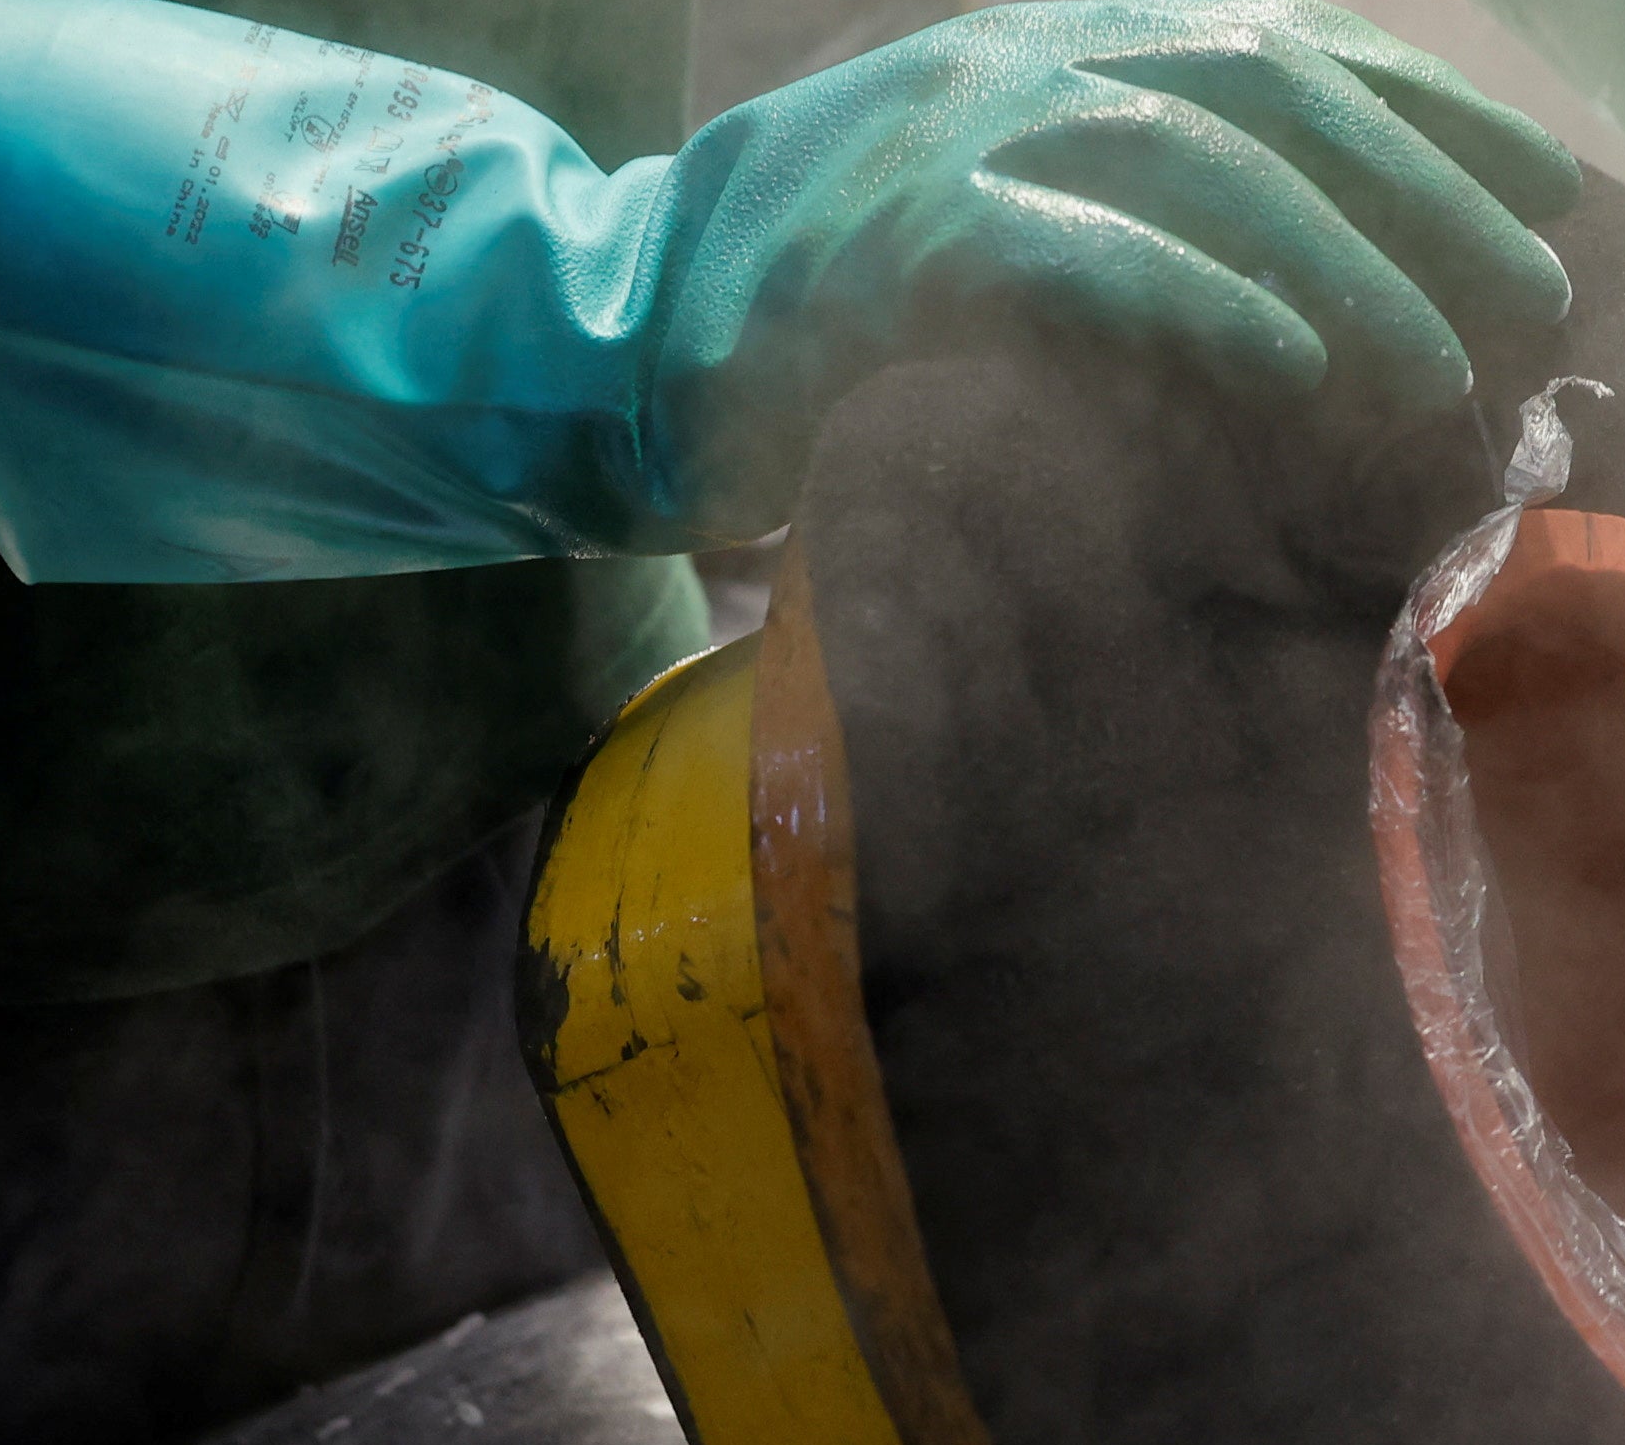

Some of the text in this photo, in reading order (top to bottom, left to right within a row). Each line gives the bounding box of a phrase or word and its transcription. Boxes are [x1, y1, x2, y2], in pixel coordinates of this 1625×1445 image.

[189, 148, 205, 169] in
[166, 178, 194, 237] China
[184, 165, 221, 245] 01.2022
[337, 189, 379, 267] Ansell
[389, 193, 447, 290] 37-675
